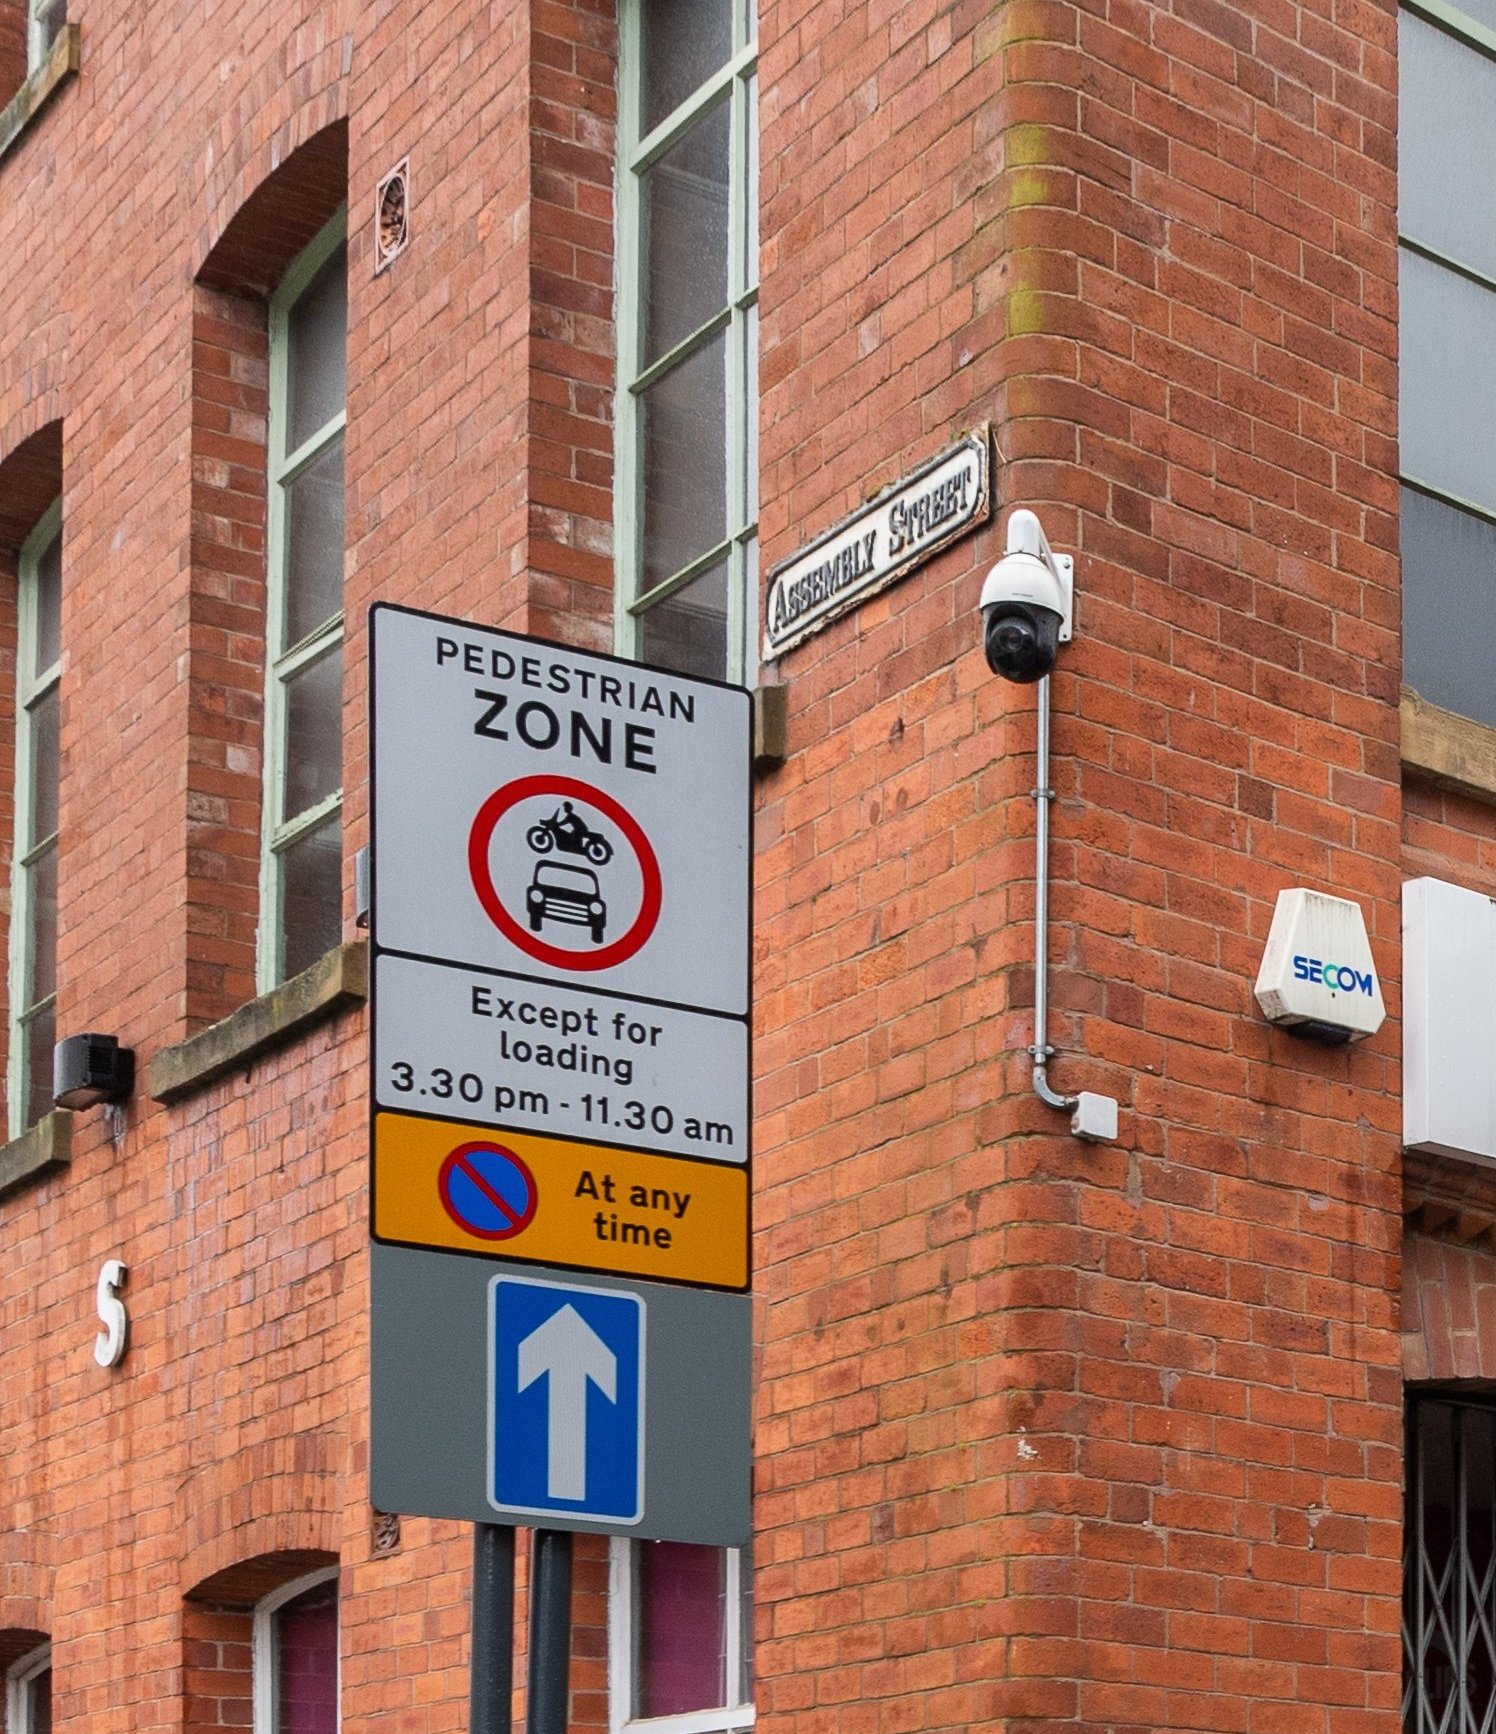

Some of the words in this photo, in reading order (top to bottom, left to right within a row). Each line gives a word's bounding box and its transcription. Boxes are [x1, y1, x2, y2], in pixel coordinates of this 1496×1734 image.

[773, 529, 877, 633] ASSEMBLY
[888, 465, 971, 557] STREET
[436, 637, 696, 723] PEDESTRIAN
[473, 688, 657, 774] ZONE
[1293, 955, 1373, 997] SECOM
[471, 986, 598, 1037] Except
[612, 1013, 663, 1047] for
[500, 1031, 633, 1086] loading
[390, 1061, 484, 1103] 3.30
[494, 1085, 549, 1113] pm
[580, 1093, 674, 1134] 11.30
[684, 1117, 734, 1146] am
[574, 1170, 616, 1203] At
[630, 1185, 691, 1219] any
[593, 1212, 672, 1250] time
[94, 1259, 129, 1368] S
